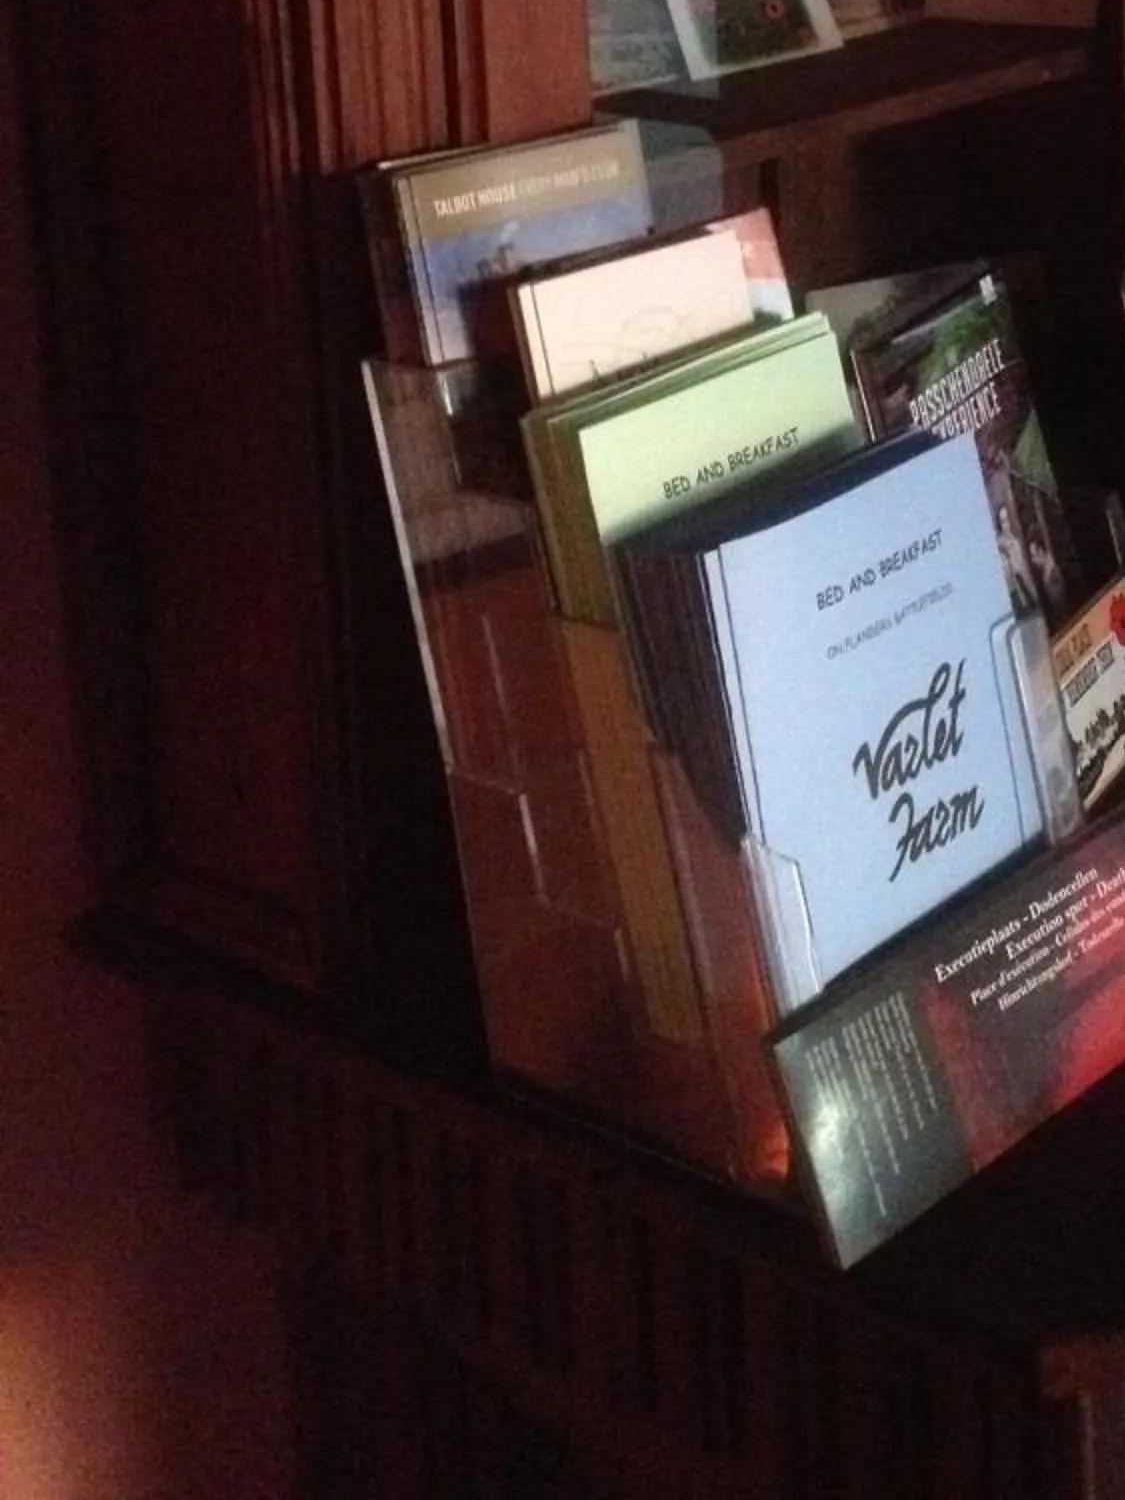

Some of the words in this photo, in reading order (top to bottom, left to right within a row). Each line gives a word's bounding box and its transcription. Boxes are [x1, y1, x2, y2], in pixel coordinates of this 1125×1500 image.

[662, 475, 691, 500] BED
[696, 459, 725, 485] AND
[728, 426, 799, 472] BREAKFAST
[815, 583, 845, 612] BED
[850, 567, 877, 594] AND
[879, 528, 943, 579] BREAKFAST
[852, 657, 966, 800] Varlet
[888, 785, 985, 883] Farm
[934, 918, 1021, 983] Executieplaats
[1029, 867, 1098, 920] Dodencellen
[1005, 914, 1063, 960] Execution
[1064, 897, 1088, 926] spot
